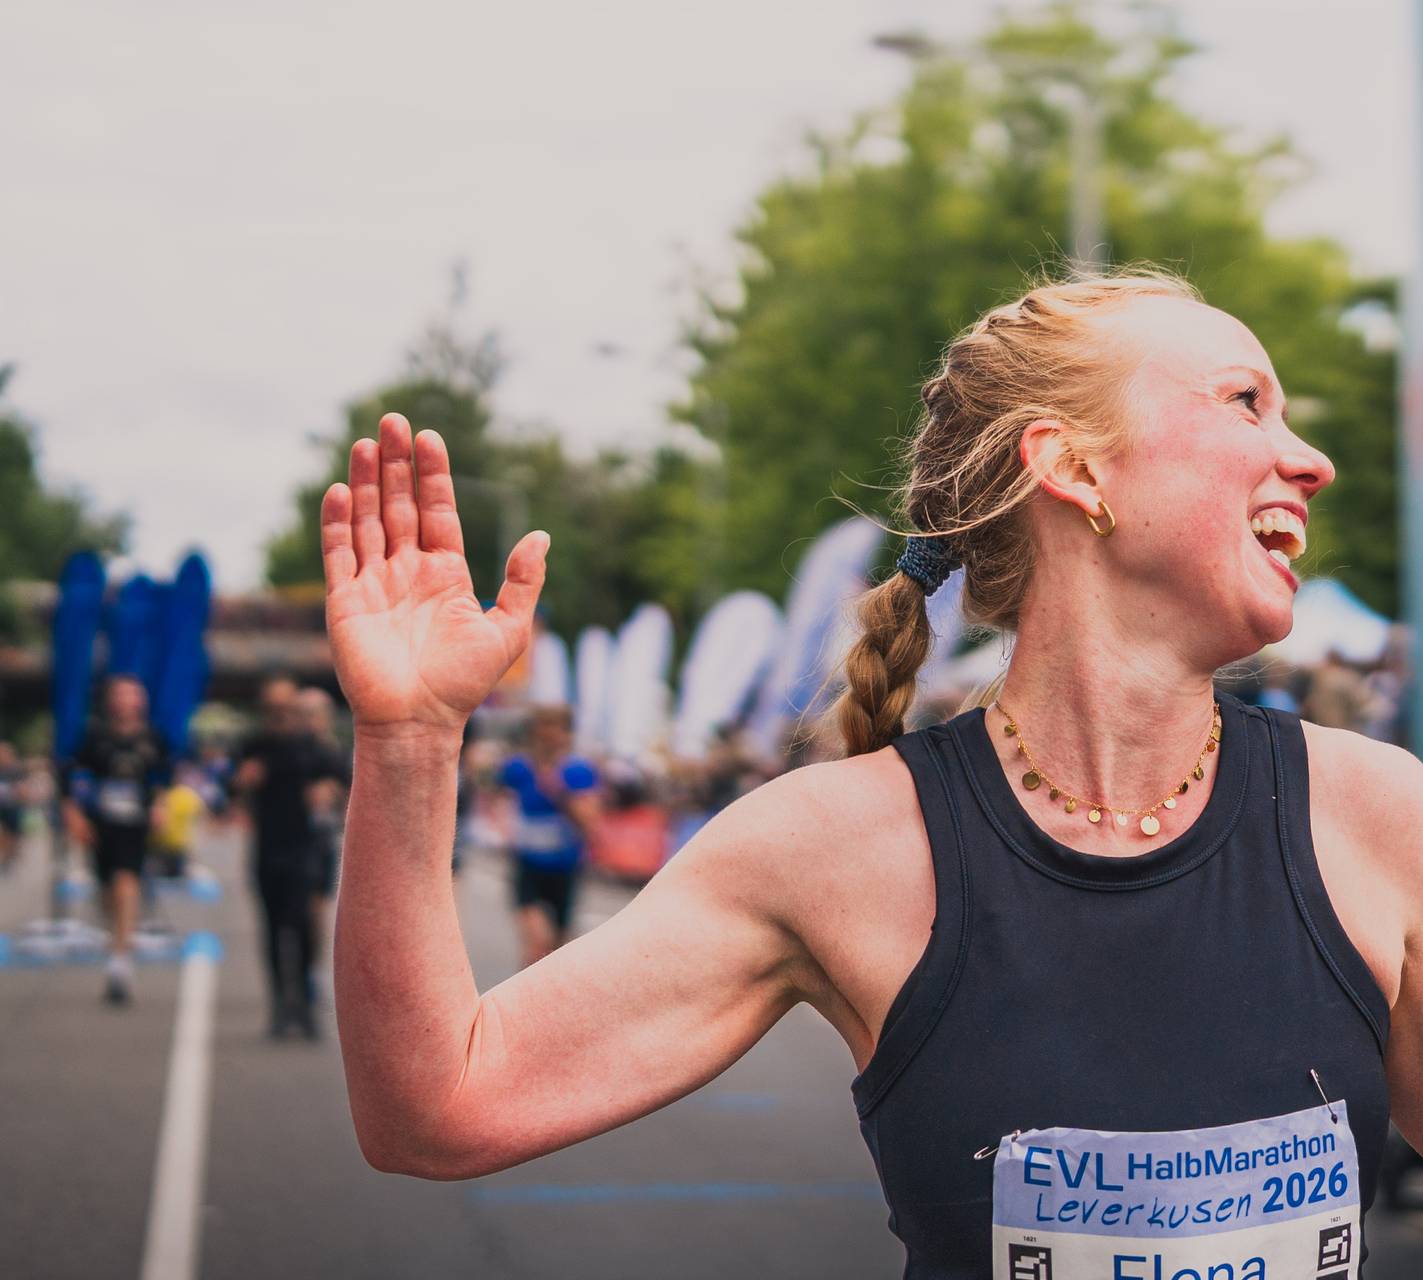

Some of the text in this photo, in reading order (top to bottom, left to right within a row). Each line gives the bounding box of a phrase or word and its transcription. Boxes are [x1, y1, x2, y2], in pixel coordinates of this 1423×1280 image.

[1023, 1132, 1335, 1192] EVL HalbMarathon
[1036, 1161, 1348, 1229] Leverkusen 2026
